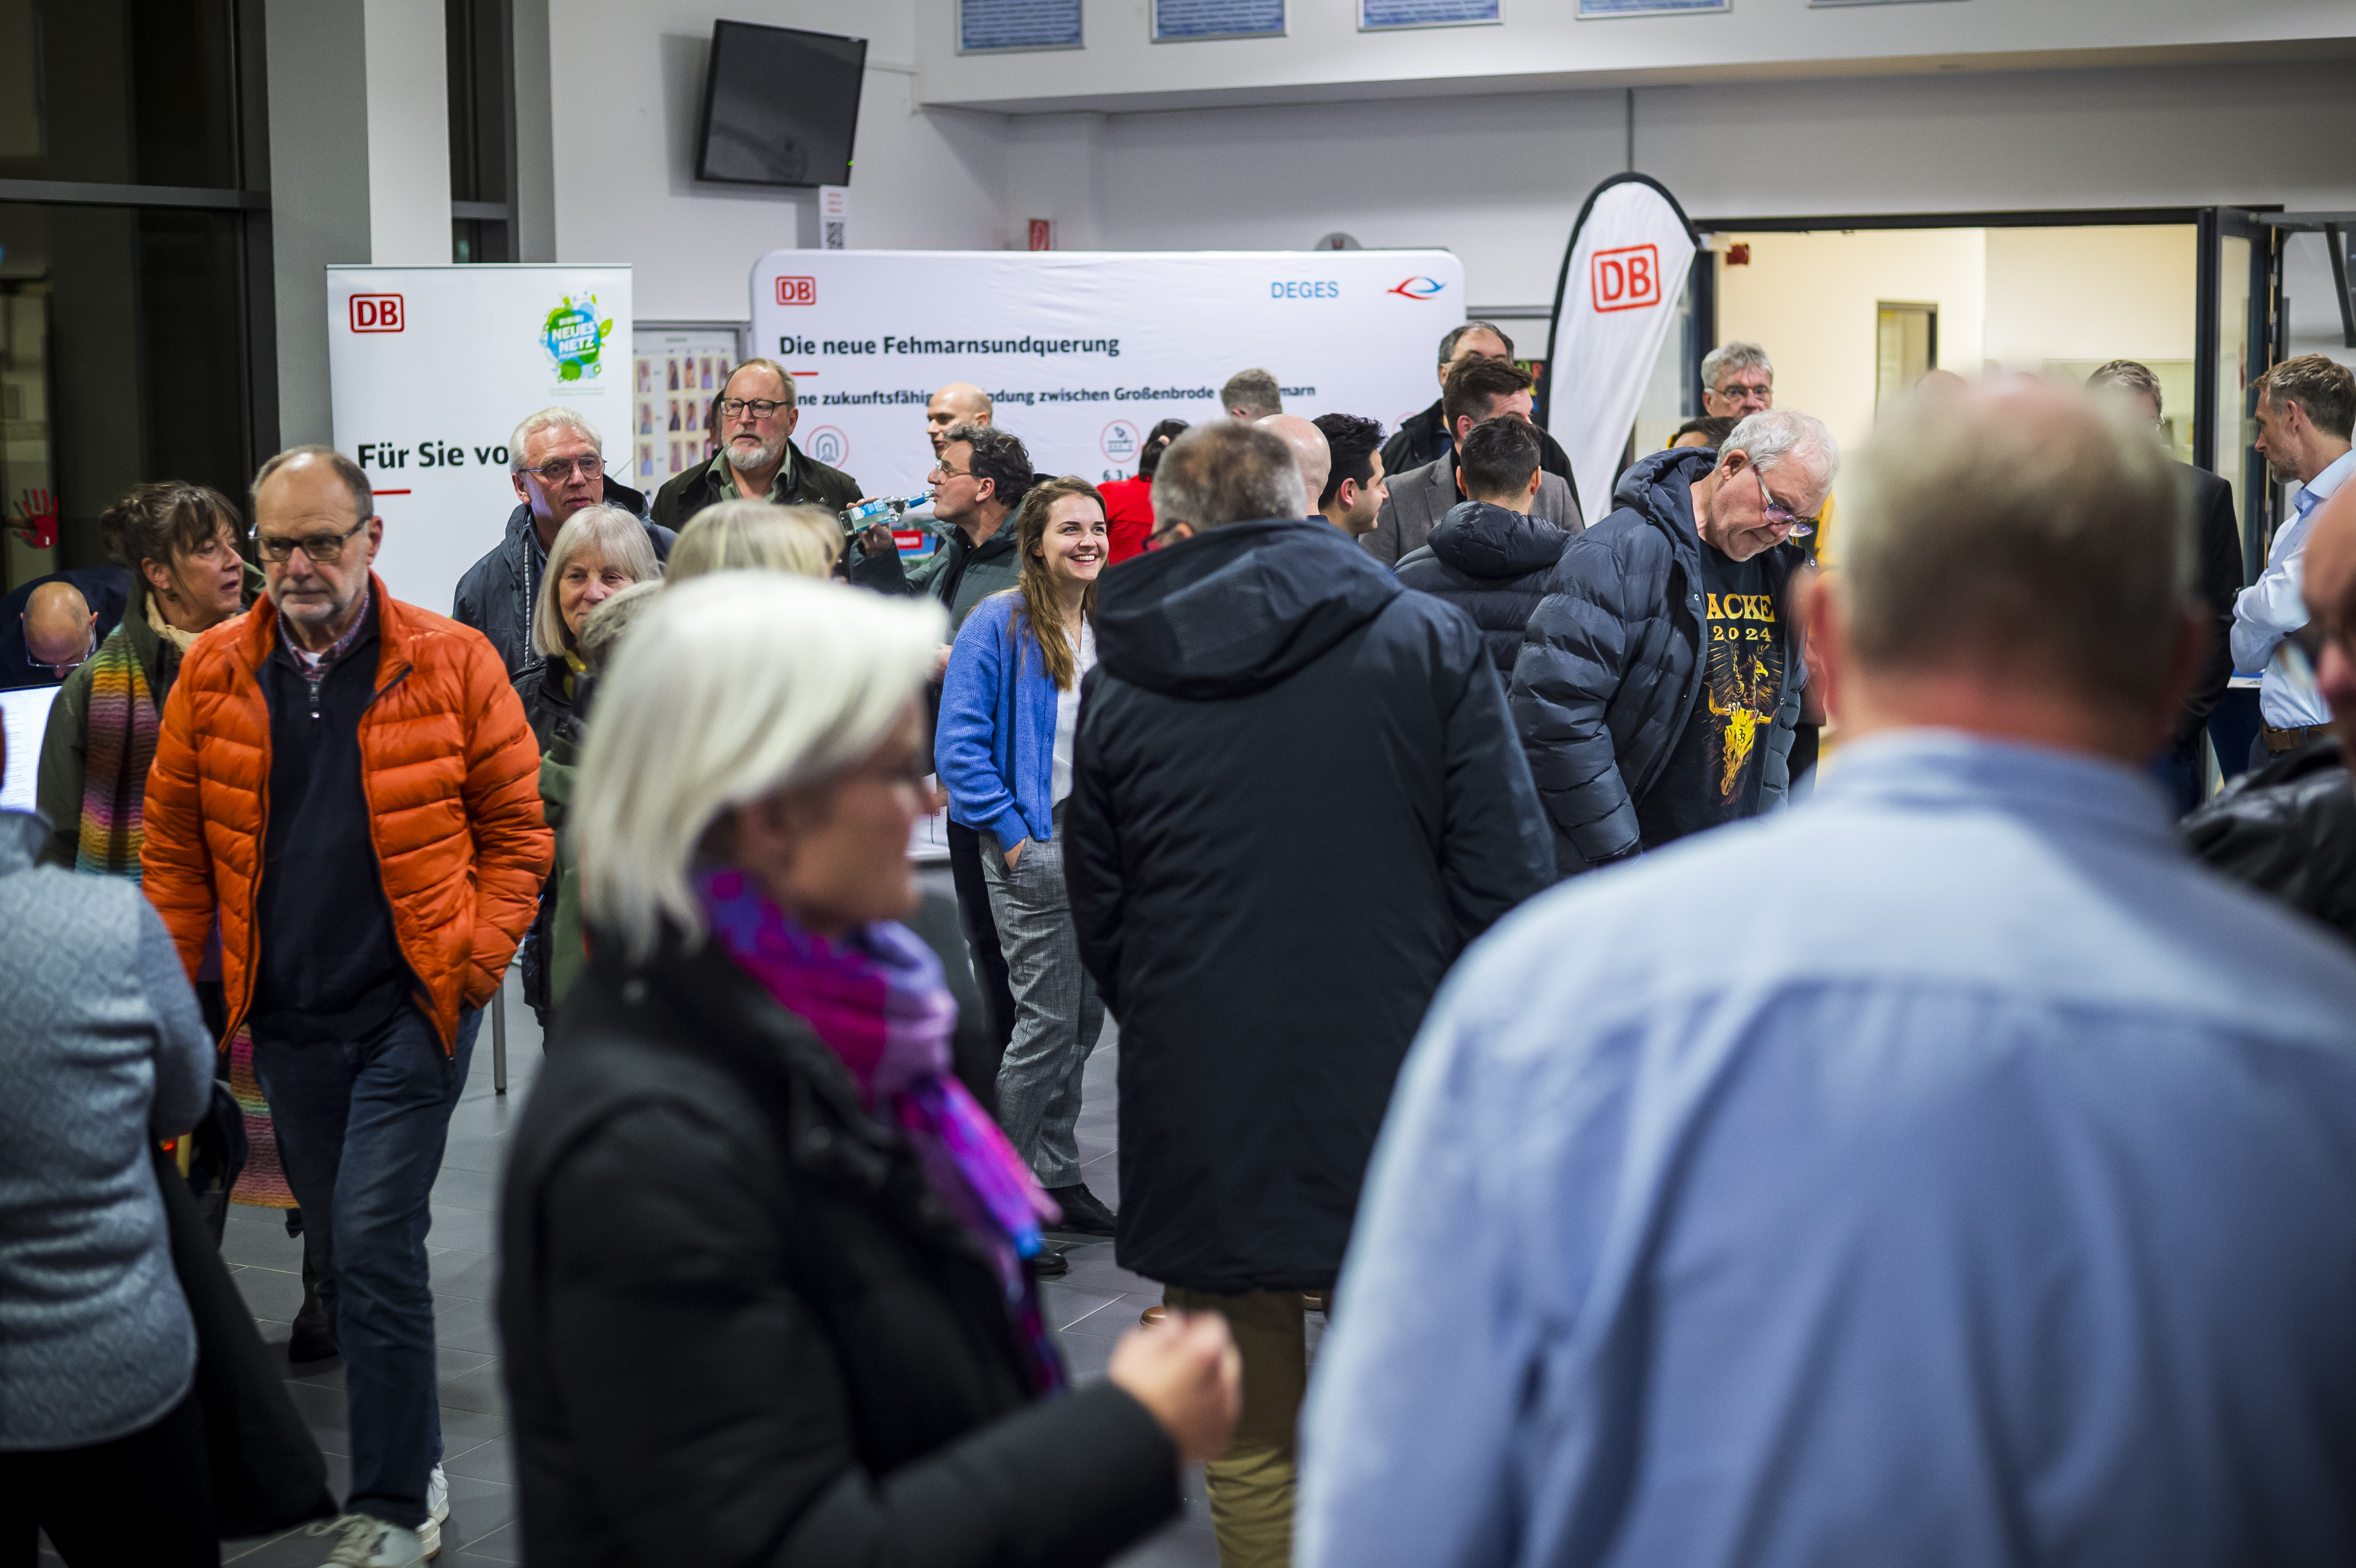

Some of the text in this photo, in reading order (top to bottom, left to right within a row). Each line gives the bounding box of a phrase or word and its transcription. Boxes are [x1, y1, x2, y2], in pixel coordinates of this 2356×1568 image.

[1599, 255, 1653, 303] DB
[781, 281, 811, 301] DB
[1271, 281, 1339, 299] DEGES
[355, 299, 399, 327] DB
[551, 321, 596, 342] NEUES
[558, 334, 594, 354] NETZ
[780, 336, 1120, 357] Die neue Fehmarnsundquerung
[822, 389, 935, 407] zukunftsfähig
[1038, 387, 1109, 402] zwischen
[1114, 386, 1214, 401] Großenbrode
[358, 440, 509, 469] Für Sie vo
[1706, 593, 1776, 622] ACKE
[1713, 625, 1772, 642] 2024
